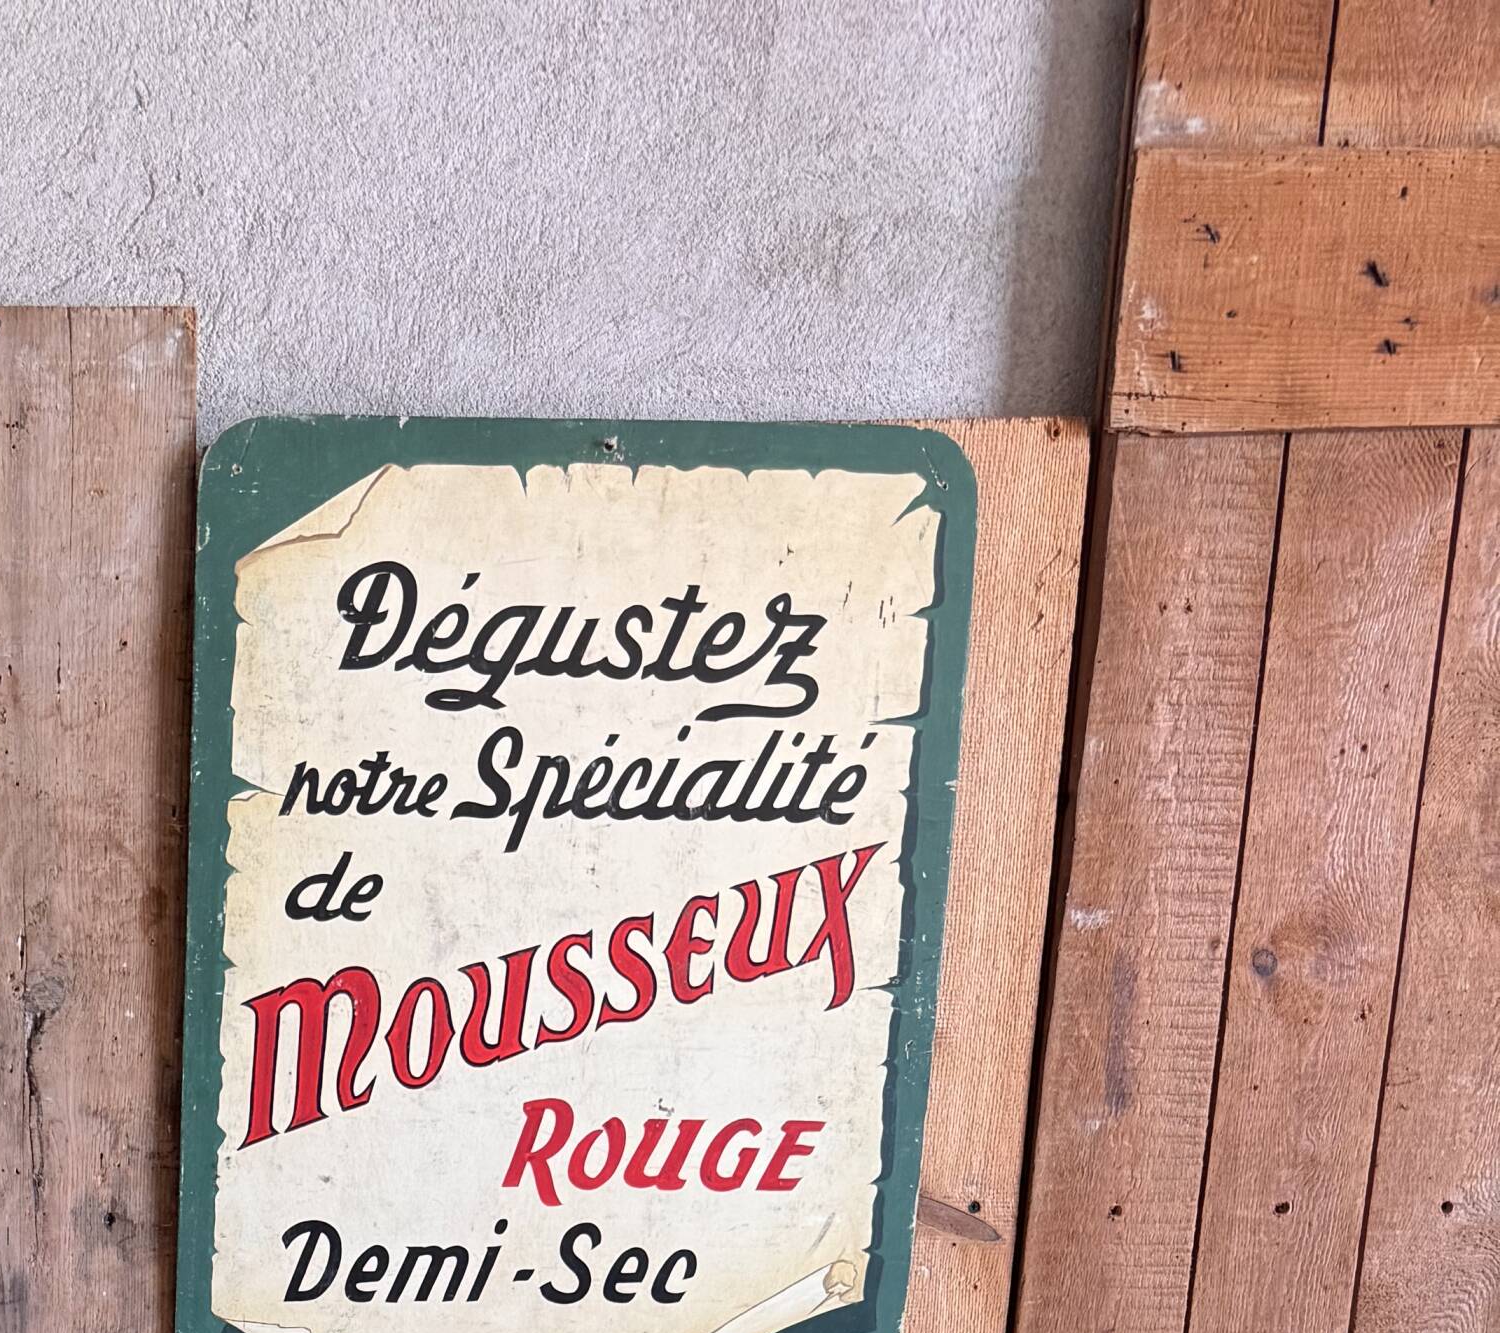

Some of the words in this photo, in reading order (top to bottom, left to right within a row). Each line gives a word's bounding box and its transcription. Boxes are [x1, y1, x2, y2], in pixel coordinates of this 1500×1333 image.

[336, 560, 827, 721] Dégustez
[279, 749, 451, 818] notre
[450, 723, 876, 852] Spécialité
[284, 850, 383, 921] de
[236, 840, 889, 1151] MOUSSEUX
[502, 1098, 827, 1206] ROUGE
